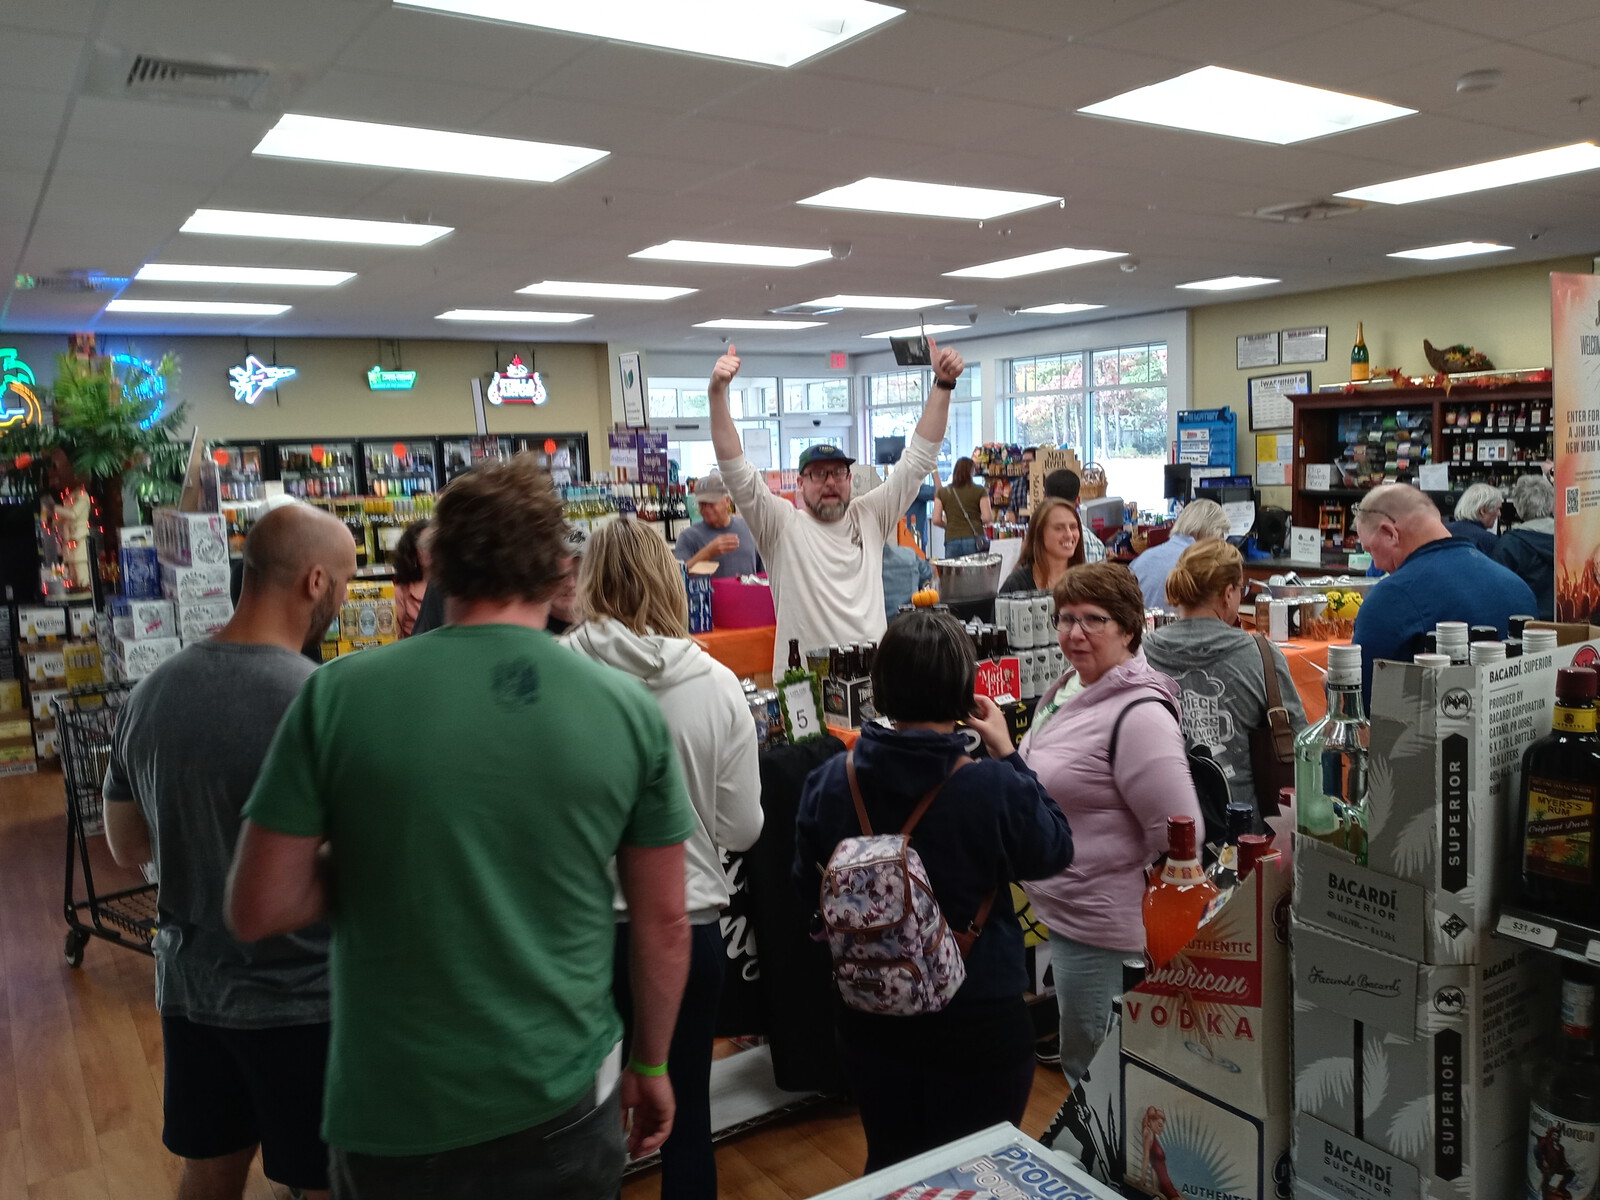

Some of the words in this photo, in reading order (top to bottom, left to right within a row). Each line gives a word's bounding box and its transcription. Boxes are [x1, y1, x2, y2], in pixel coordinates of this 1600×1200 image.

[1580, 335, 1600, 355] WELCOM
[1566, 410, 1586, 423] ENTER
[1588, 409, 1600, 421] FOR
[1568, 427, 1573, 438] A
[1574, 426, 1586, 437] JIM
[1587, 424, 1600, 436] BEA
[1565, 442, 1579, 454] NEW
[1581, 441, 1595, 453] MGM
[1044, 459, 1067, 469] RIVER
[982, 667, 1004, 685] Mad
[1489, 660, 1523, 683] BACARDÍ
[1523, 655, 1553, 674] SUPERIOR
[1489, 693, 1519, 710] PRODUCED
[1519, 690, 1524, 702] BY
[796, 709, 808, 729] 5
[1489, 709, 1511, 725] BACARDI
[1512, 698, 1546, 719] CORPORATION
[1182, 717, 1218, 729] MASS
[1510, 721, 1517, 733] PR
[1193, 728, 1218, 739] EVERY
[1199, 736, 1219, 747] ASS
[1513, 728, 1537, 745] BOTTLES
[1501, 748, 1519, 765] LITERS
[1537, 796, 1583, 811] MYERS'S
[1548, 806, 1570, 816] RUM
[1448, 760, 1460, 866] SUPERIOR
[1528, 822, 1563, 834] Original
[1565, 819, 1590, 831] Dark
[1329, 872, 1398, 911] BACARDÍ
[1327, 890, 1396, 922] SUPERIOR
[1126, 1001, 1255, 1041] VODKA
[1442, 1055, 1454, 1155] SUPERIOR
[1557, 1120, 1595, 1143] Morgan
[1324, 1139, 1393, 1187] BACARDÍ
[1324, 1156, 1391, 1197] SUPERIOR
[1182, 1183, 1253, 1200] AUTHENT
